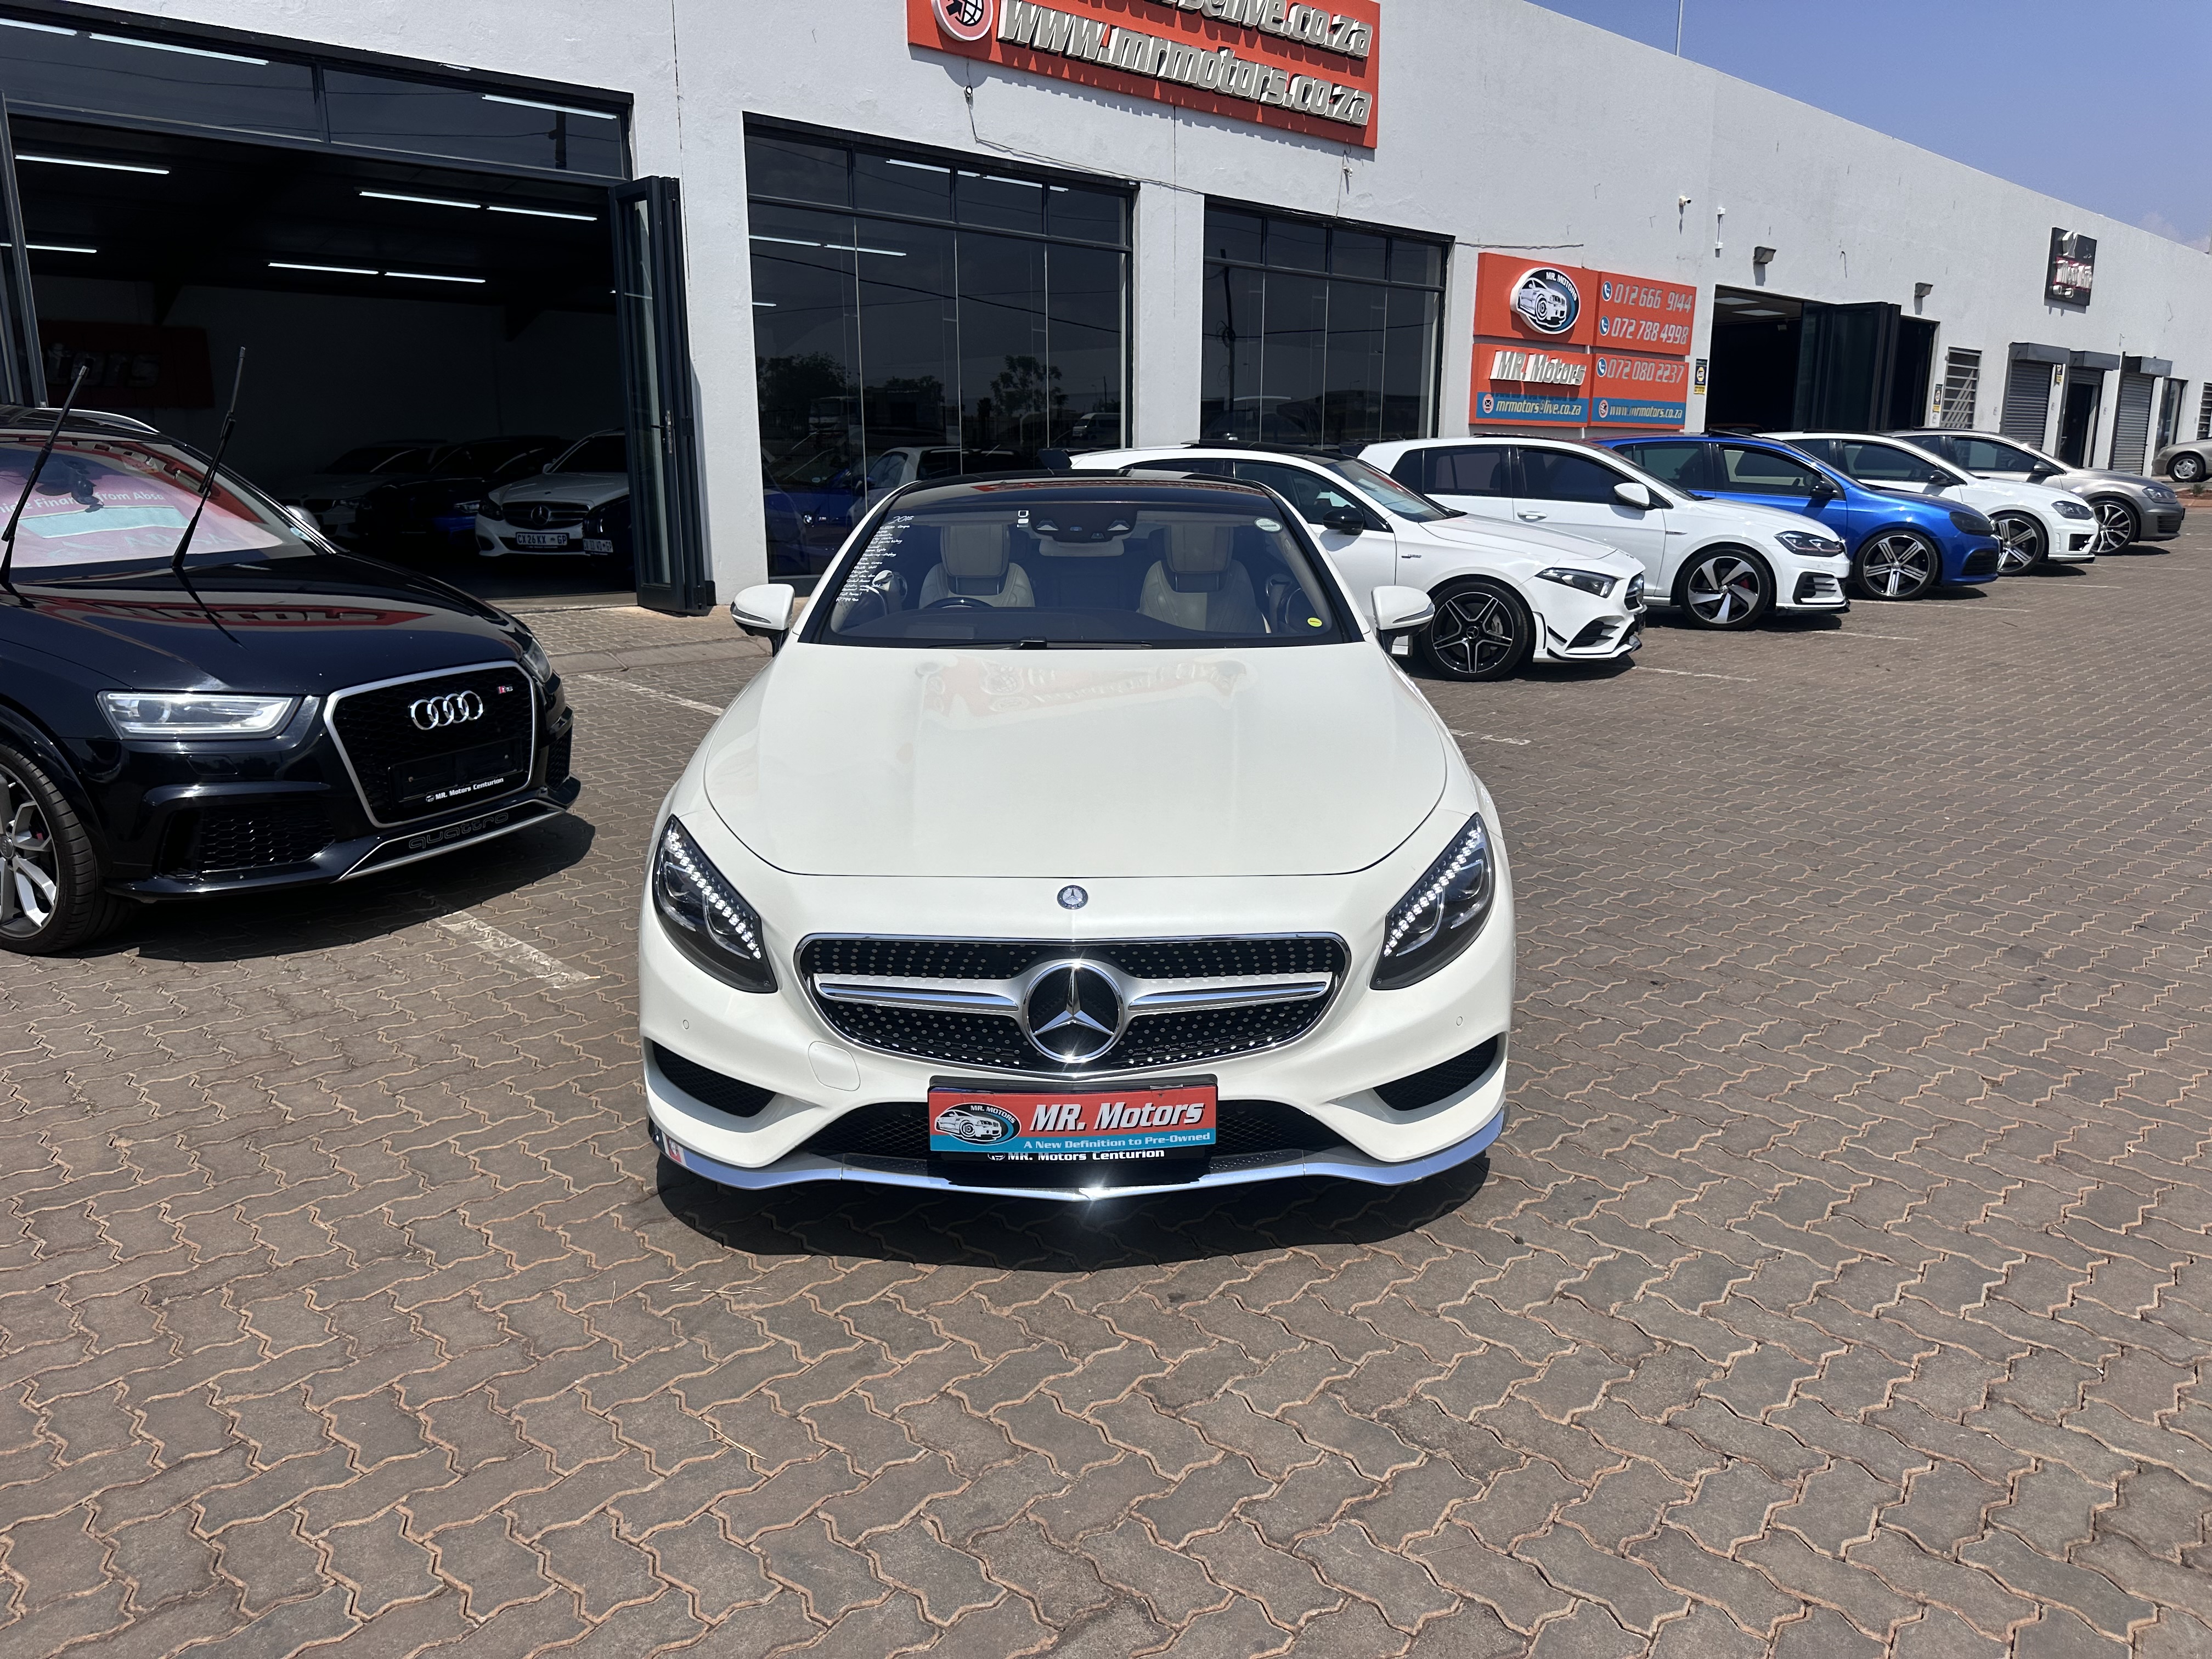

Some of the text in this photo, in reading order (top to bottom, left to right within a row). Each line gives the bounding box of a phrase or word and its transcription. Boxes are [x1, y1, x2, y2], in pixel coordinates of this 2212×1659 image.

[997, 0, 1372, 126] www.mrmotors.co.za
[1545, 272, 1577, 301] MR. MOTORS
[1614, 283, 1693, 313] 012 666 9144
[1611, 317, 1689, 345] 072 788 4998
[1490, 351, 1587, 385] MR. Motors
[1607, 358, 1685, 383] 072 080 2237
[95, 492, 131, 502] from
[134, 491, 165, 501] Absa
[888, 516, 915, 524] 2015
[517, 534, 567, 544] CX 26 KX GP
[435, 777, 504, 800] MR. Motors Centurion
[409, 812, 509, 849] quattro
[986, 1106, 1016, 1124] MOTORS
[1029, 1102, 1205, 1131] MR. Motors
[1023, 1141, 1032, 1149] A
[1036, 1140, 1062, 1149] New
[1065, 1137, 1125, 1148] Definition
[1145, 1132, 1210, 1145] Pre-Owned
[1008, 1149, 1165, 1161] MR. Motors Centurion
